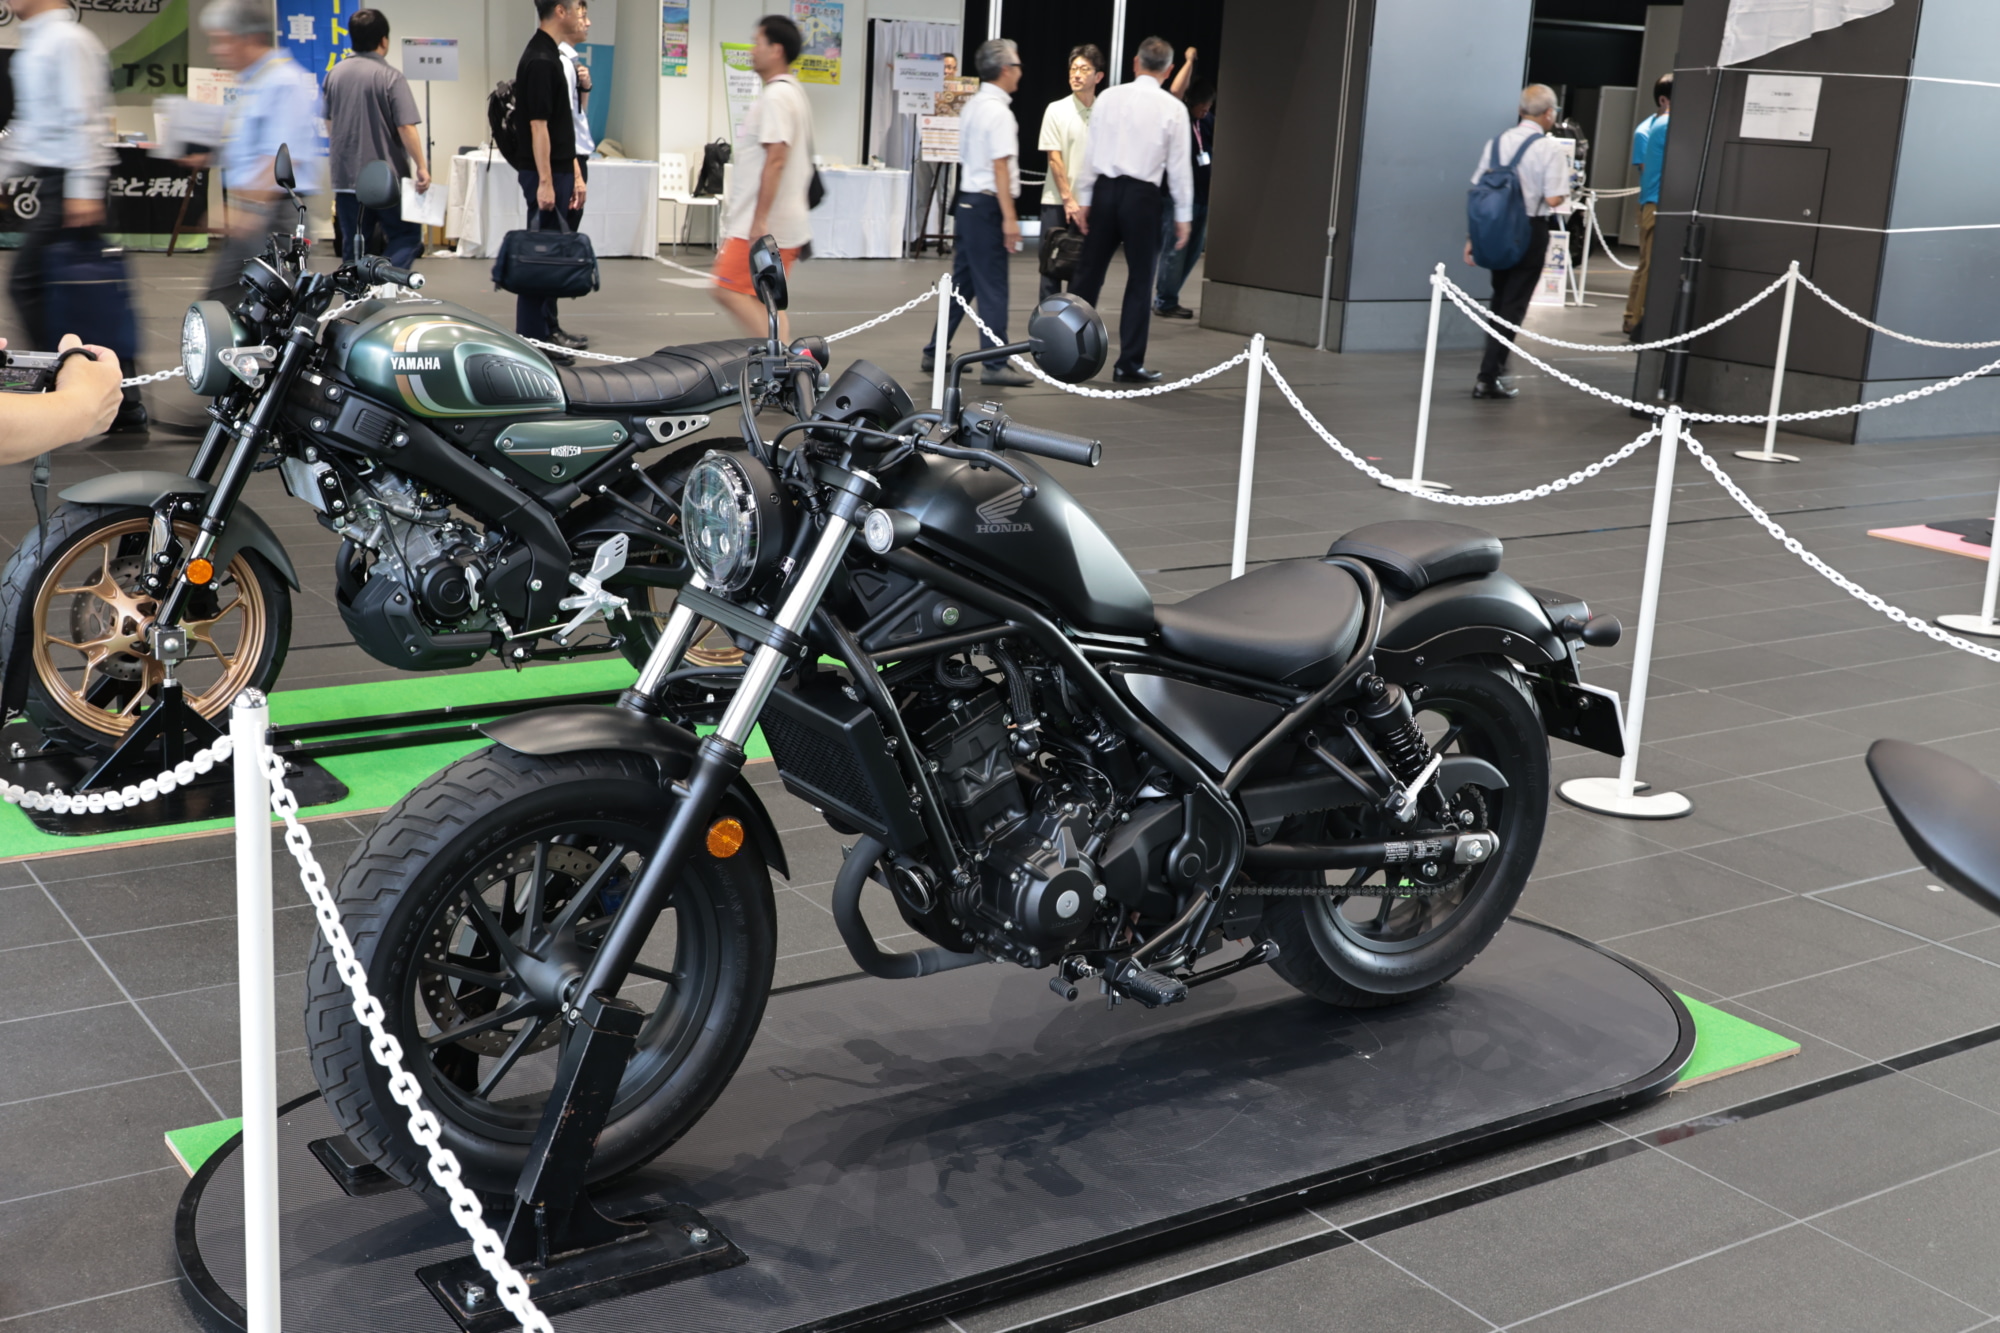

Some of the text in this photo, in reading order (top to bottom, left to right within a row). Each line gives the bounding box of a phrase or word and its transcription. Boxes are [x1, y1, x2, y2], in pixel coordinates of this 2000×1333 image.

[112, 63, 188, 88] TSU
[390, 356, 441, 370] YAMAHA
[976, 523, 1034, 533] HONDA
